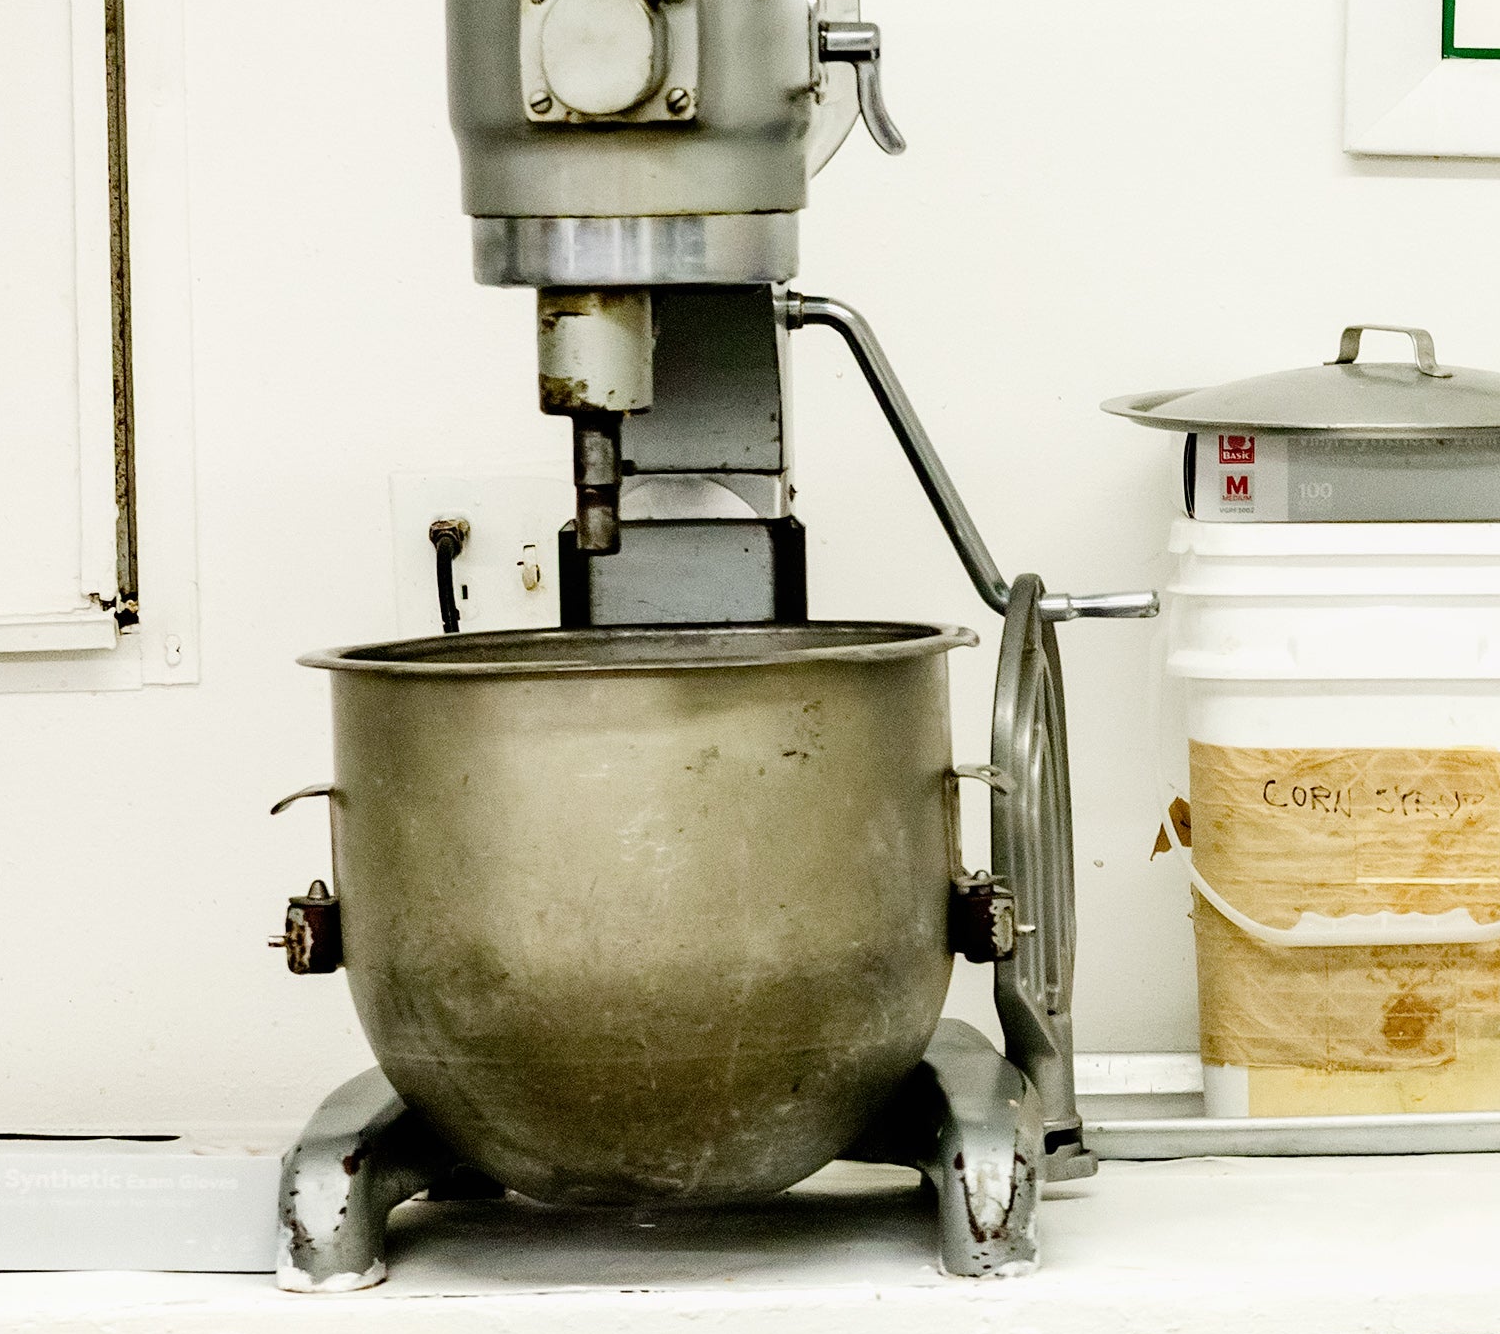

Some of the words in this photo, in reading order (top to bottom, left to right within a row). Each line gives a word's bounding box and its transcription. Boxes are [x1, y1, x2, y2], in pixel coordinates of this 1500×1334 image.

[1226, 475, 1249, 495] M
[1298, 483, 1333, 500] 100
[1263, 778, 1352, 818] CORN
[1375, 784, 1485, 818] SYRUP
[5, 1168, 122, 1194] Synthetic
